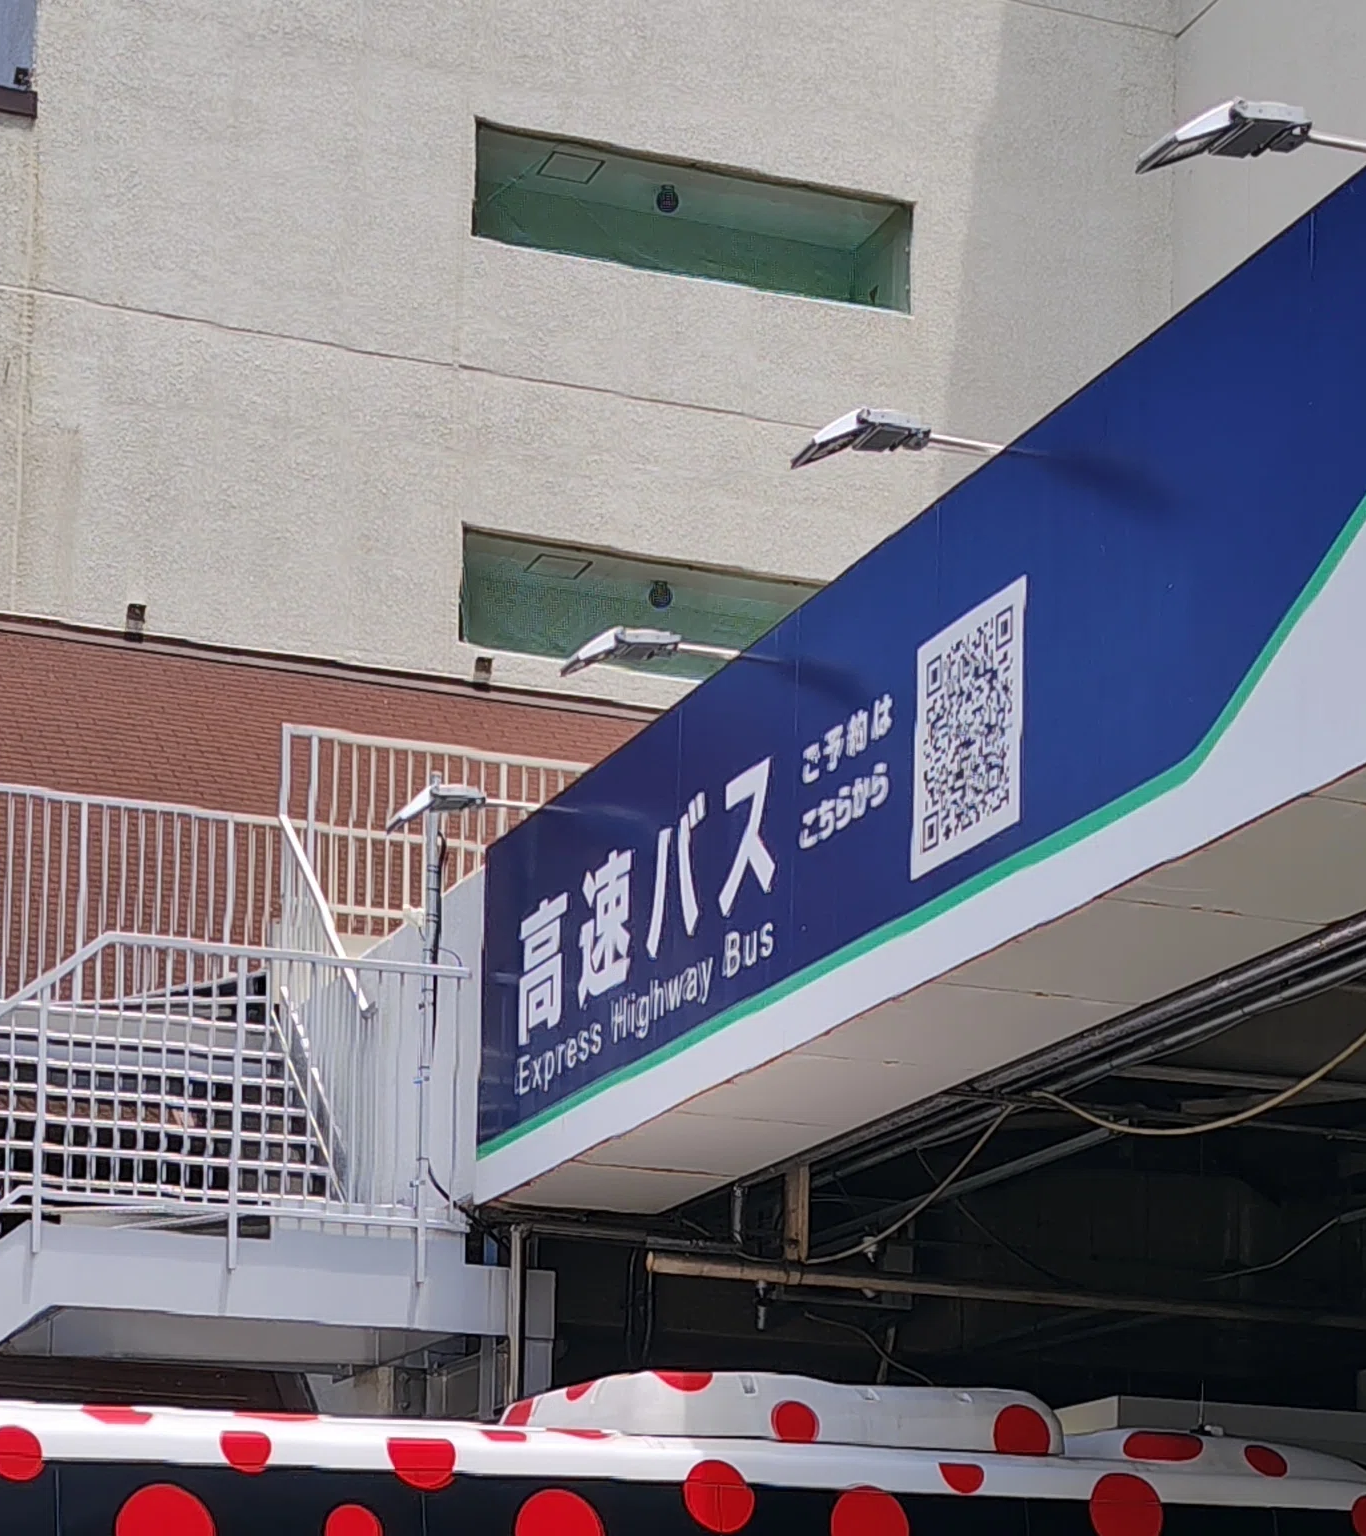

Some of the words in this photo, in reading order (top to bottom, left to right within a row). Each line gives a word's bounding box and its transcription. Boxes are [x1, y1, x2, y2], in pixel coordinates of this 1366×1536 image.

[801, 694, 893, 783] ご予約は
[798, 762, 891, 850] こちらから
[517, 756, 776, 1045] 高速バス
[517, 1019, 603, 1096] Express
[612, 954, 714, 1044] Highway
[723, 921, 775, 979] Bus
